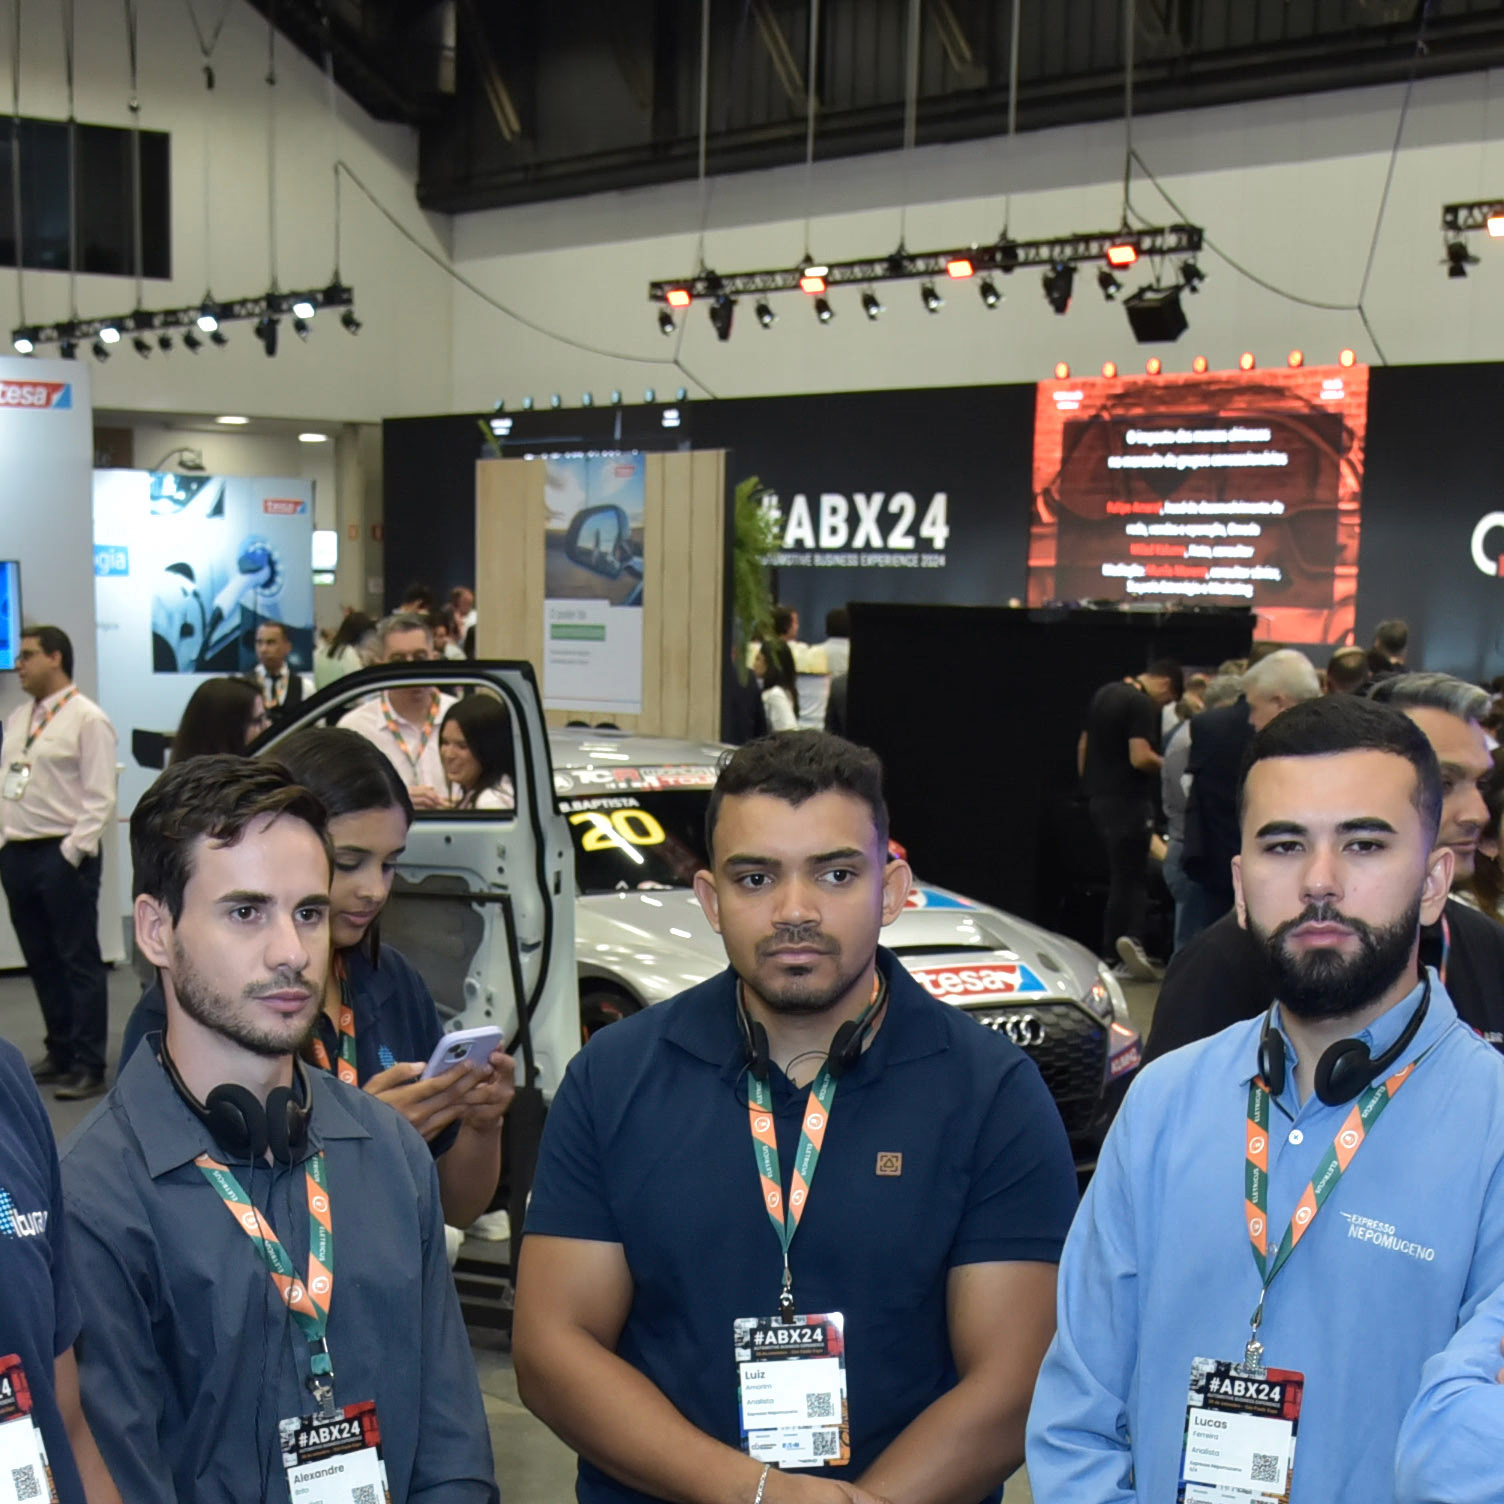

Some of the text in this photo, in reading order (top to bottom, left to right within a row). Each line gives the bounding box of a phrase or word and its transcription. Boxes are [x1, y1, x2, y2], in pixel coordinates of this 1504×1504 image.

[814, 553, 859, 567] BUSINESS
[861, 553, 918, 567] EXPERIENCE
[569, 809, 666, 852] 20
[919, 969, 1006, 995] tesa
[1351, 1214, 1396, 1235] EXPRESSO
[1347, 1223, 1435, 1262] NEPOMUCENO
[754, 1328, 823, 1346] #ABX24
[745, 1370, 765, 1380] Luiz
[1209, 1377, 1281, 1402] #ABX24
[1194, 1416, 1228, 1430] Lucas
[298, 1420, 361, 1448] #ABX24
[1193, 1430, 1219, 1441] Ferreira
[1191, 1446, 1220, 1457] Analista
[294, 1463, 344, 1484] Alexandre
